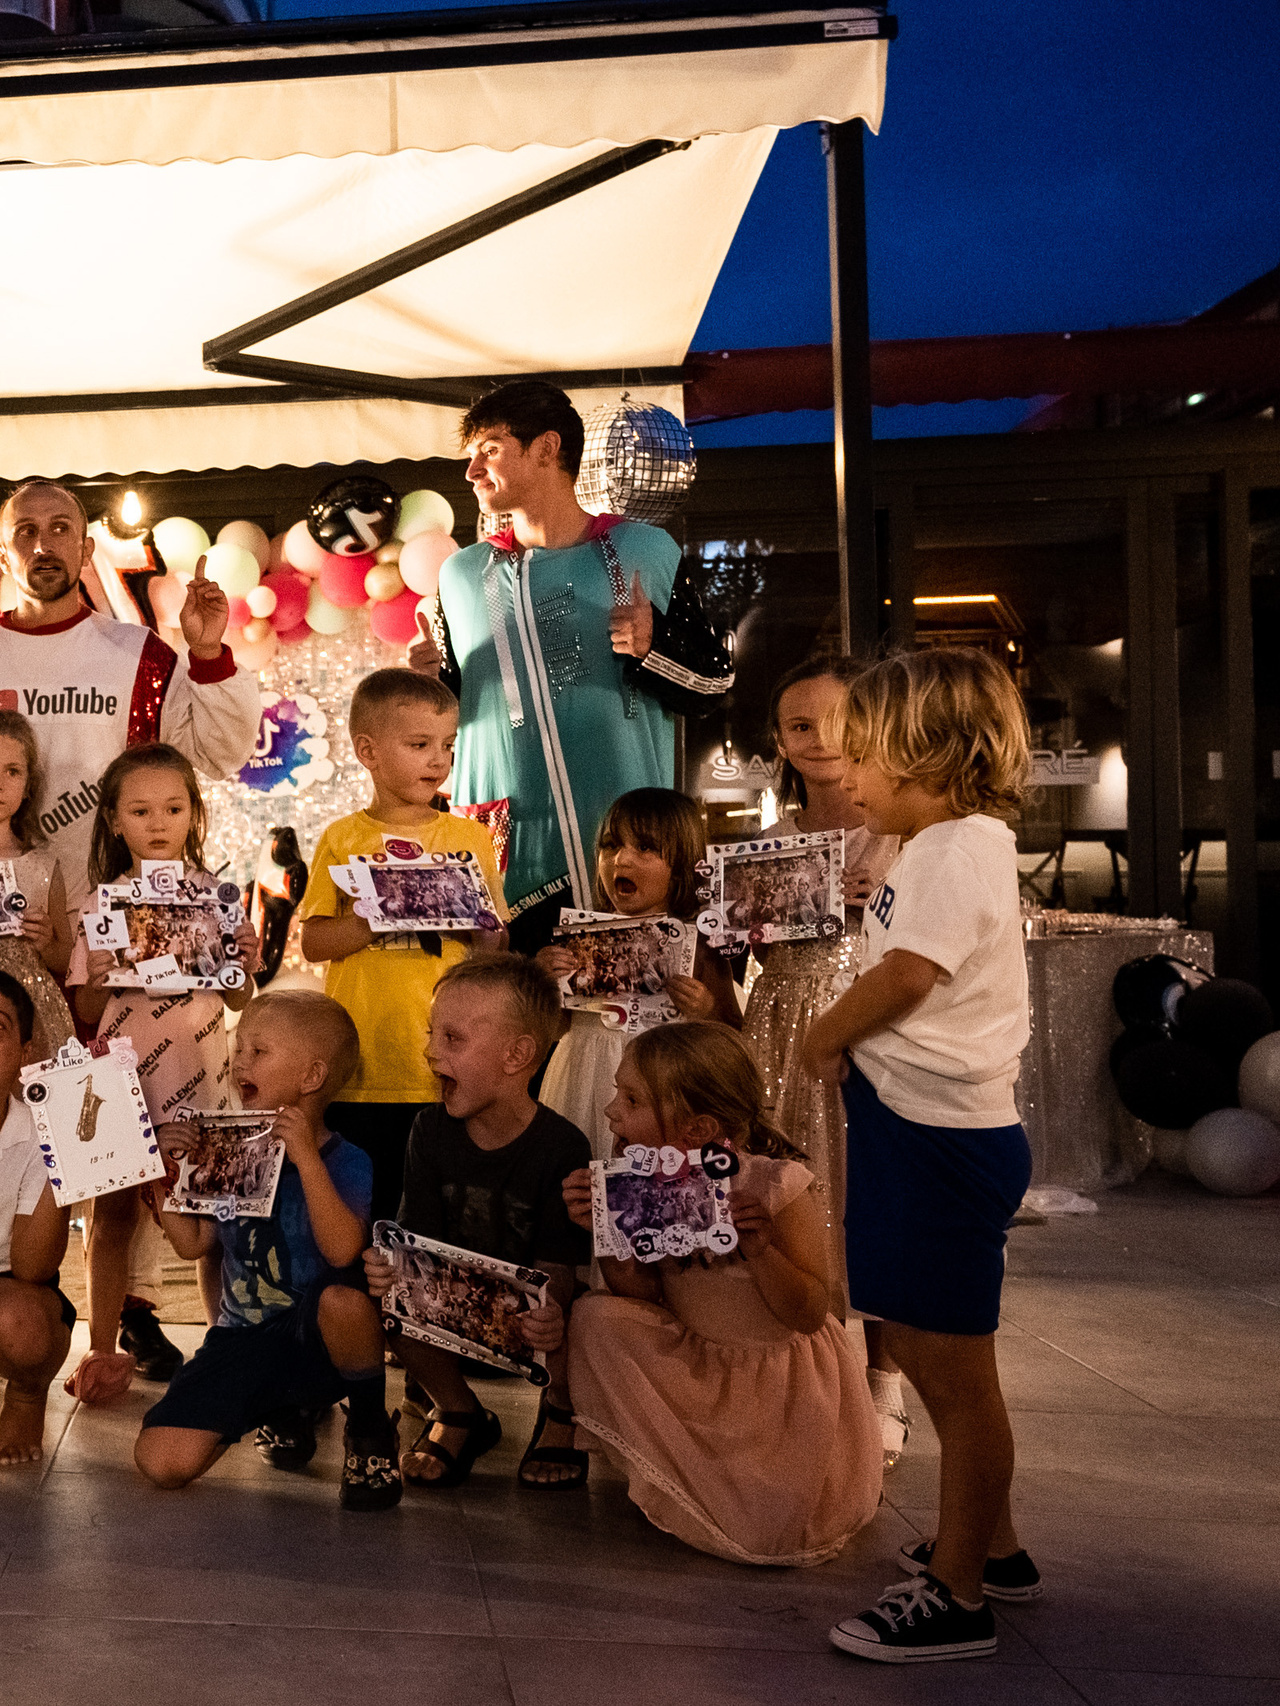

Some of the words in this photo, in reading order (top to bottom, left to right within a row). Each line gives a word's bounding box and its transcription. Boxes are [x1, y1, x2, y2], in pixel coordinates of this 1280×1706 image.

[23, 686, 117, 716] YouTube
[519, 889, 547, 910] SMALL
[543, 878, 565, 896] TALK
[62, 1057, 84, 1068] Like
[137, 1038, 174, 1078] ENCIAGA
[161, 1068, 207, 1114] BALENCIAGA
[642, 1150, 656, 1173] Like
